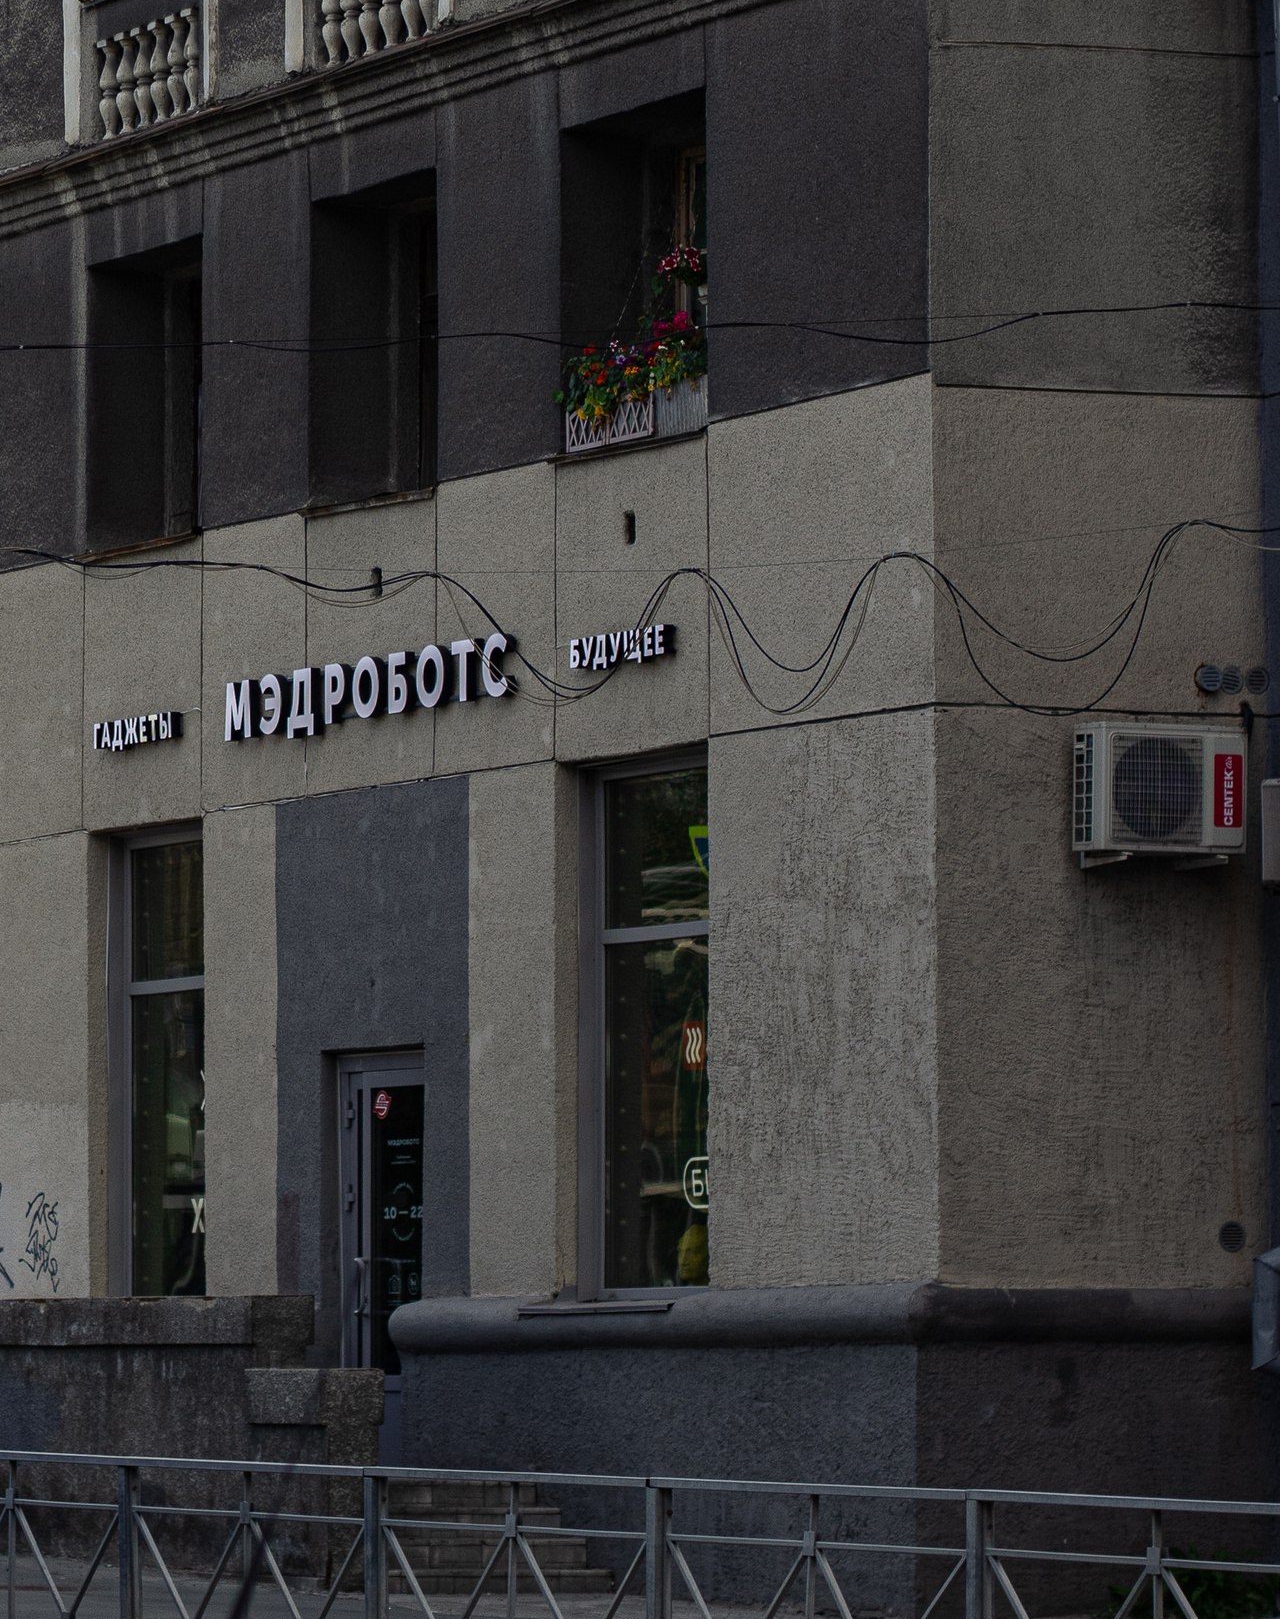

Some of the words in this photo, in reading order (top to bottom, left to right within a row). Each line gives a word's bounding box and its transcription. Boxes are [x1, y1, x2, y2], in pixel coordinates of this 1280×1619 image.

[570, 624, 666, 670] БУДУЩЕЕ
[224, 633, 509, 742] МЭДРОБОТС
[93, 713, 173, 750] ГАДЖЕТЫ
[1223, 770, 1234, 826] CENTEK
[384, 1206, 397, 1219] 10
